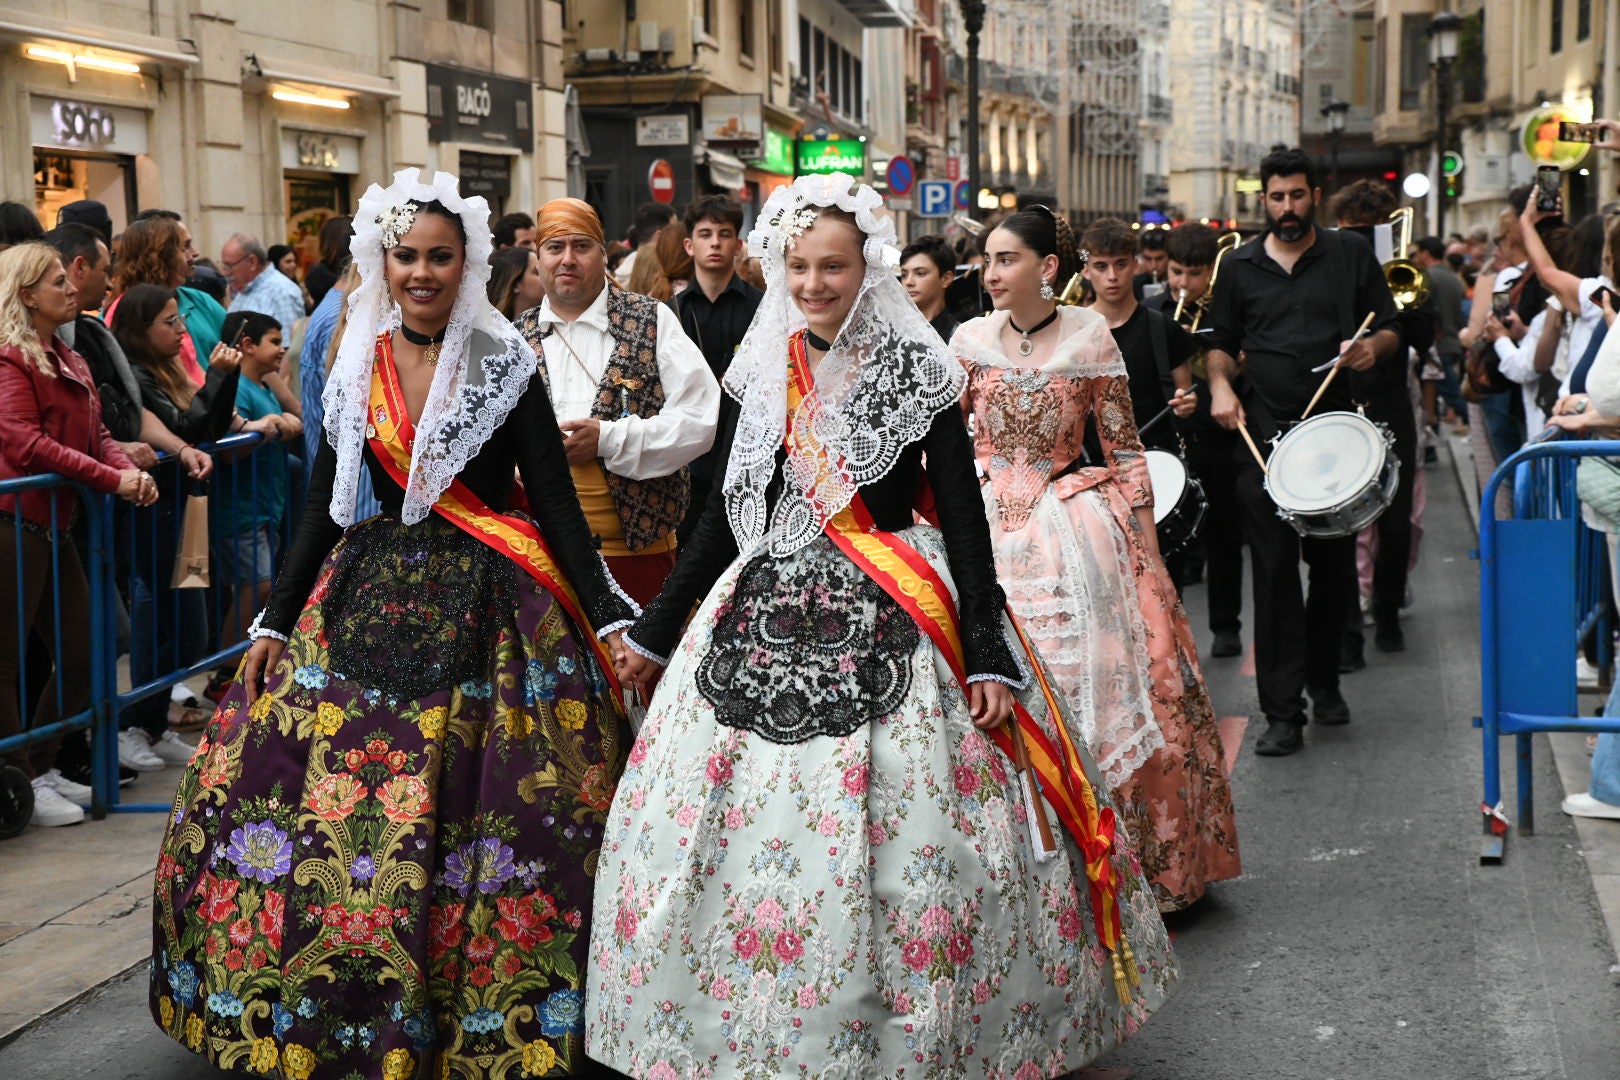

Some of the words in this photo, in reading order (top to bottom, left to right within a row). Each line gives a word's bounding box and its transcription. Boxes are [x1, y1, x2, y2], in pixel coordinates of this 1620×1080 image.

[457, 82, 491, 117] RACÓ
[800, 155, 863, 171] LUFRAN
[925, 184, 947, 213] P
[897, 575, 950, 631] Sur
